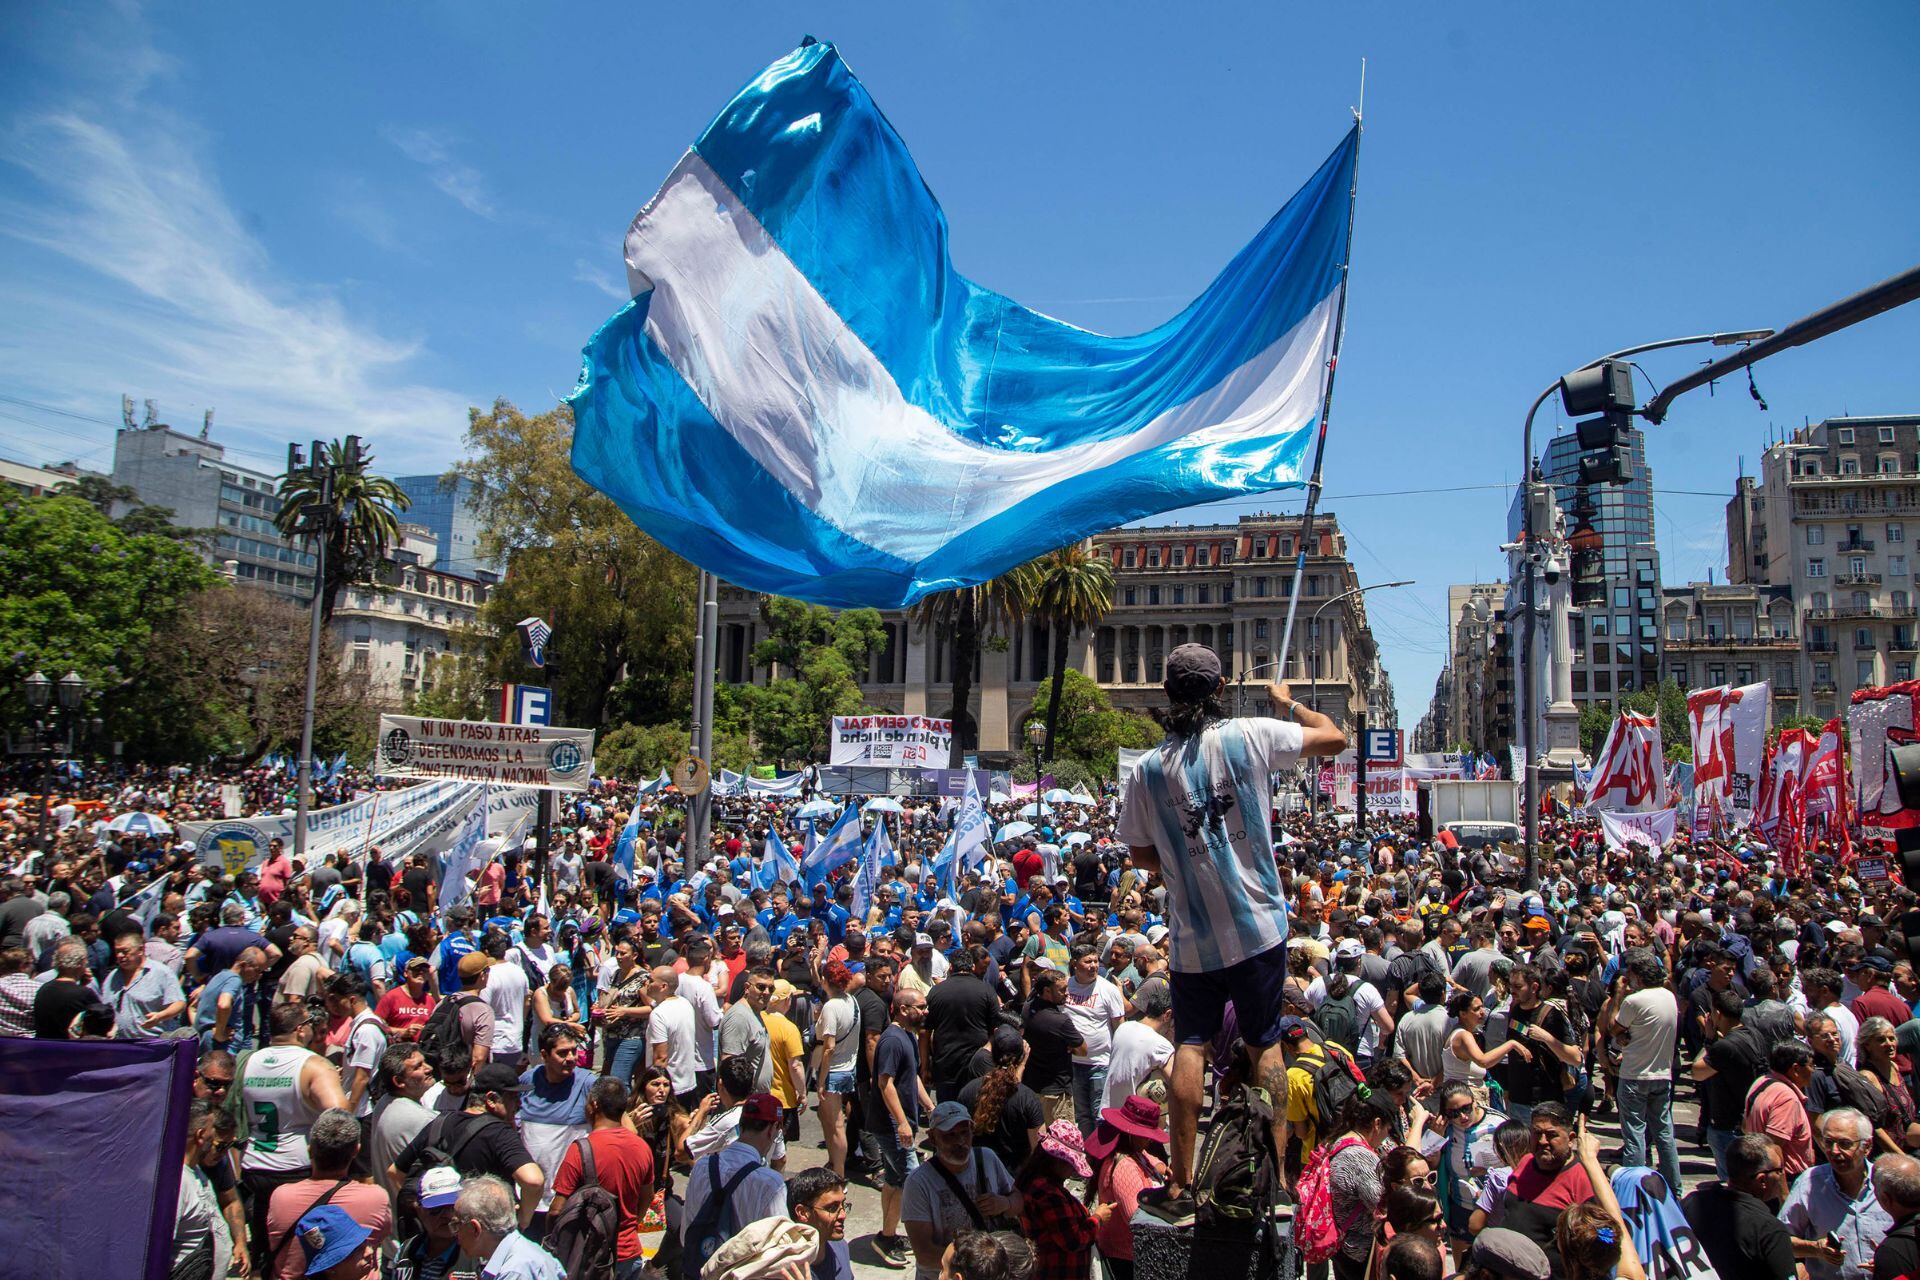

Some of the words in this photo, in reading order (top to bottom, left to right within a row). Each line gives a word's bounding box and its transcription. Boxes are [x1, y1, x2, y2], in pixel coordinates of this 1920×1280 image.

[521, 691, 546, 727] E
[421, 720, 434, 736] NI
[439, 721, 455, 738] UN
[460, 723, 493, 741] PASO
[498, 726, 541, 744] ATRAS
[1370, 731, 1390, 756] E
[419, 742, 500, 762] DEFENDAMOS
[505, 748, 524, 764] LA
[501, 767, 550, 785] NACIONAL
[398, 1007, 429, 1015] NICCE
[253, 1101, 279, 1153] 3
